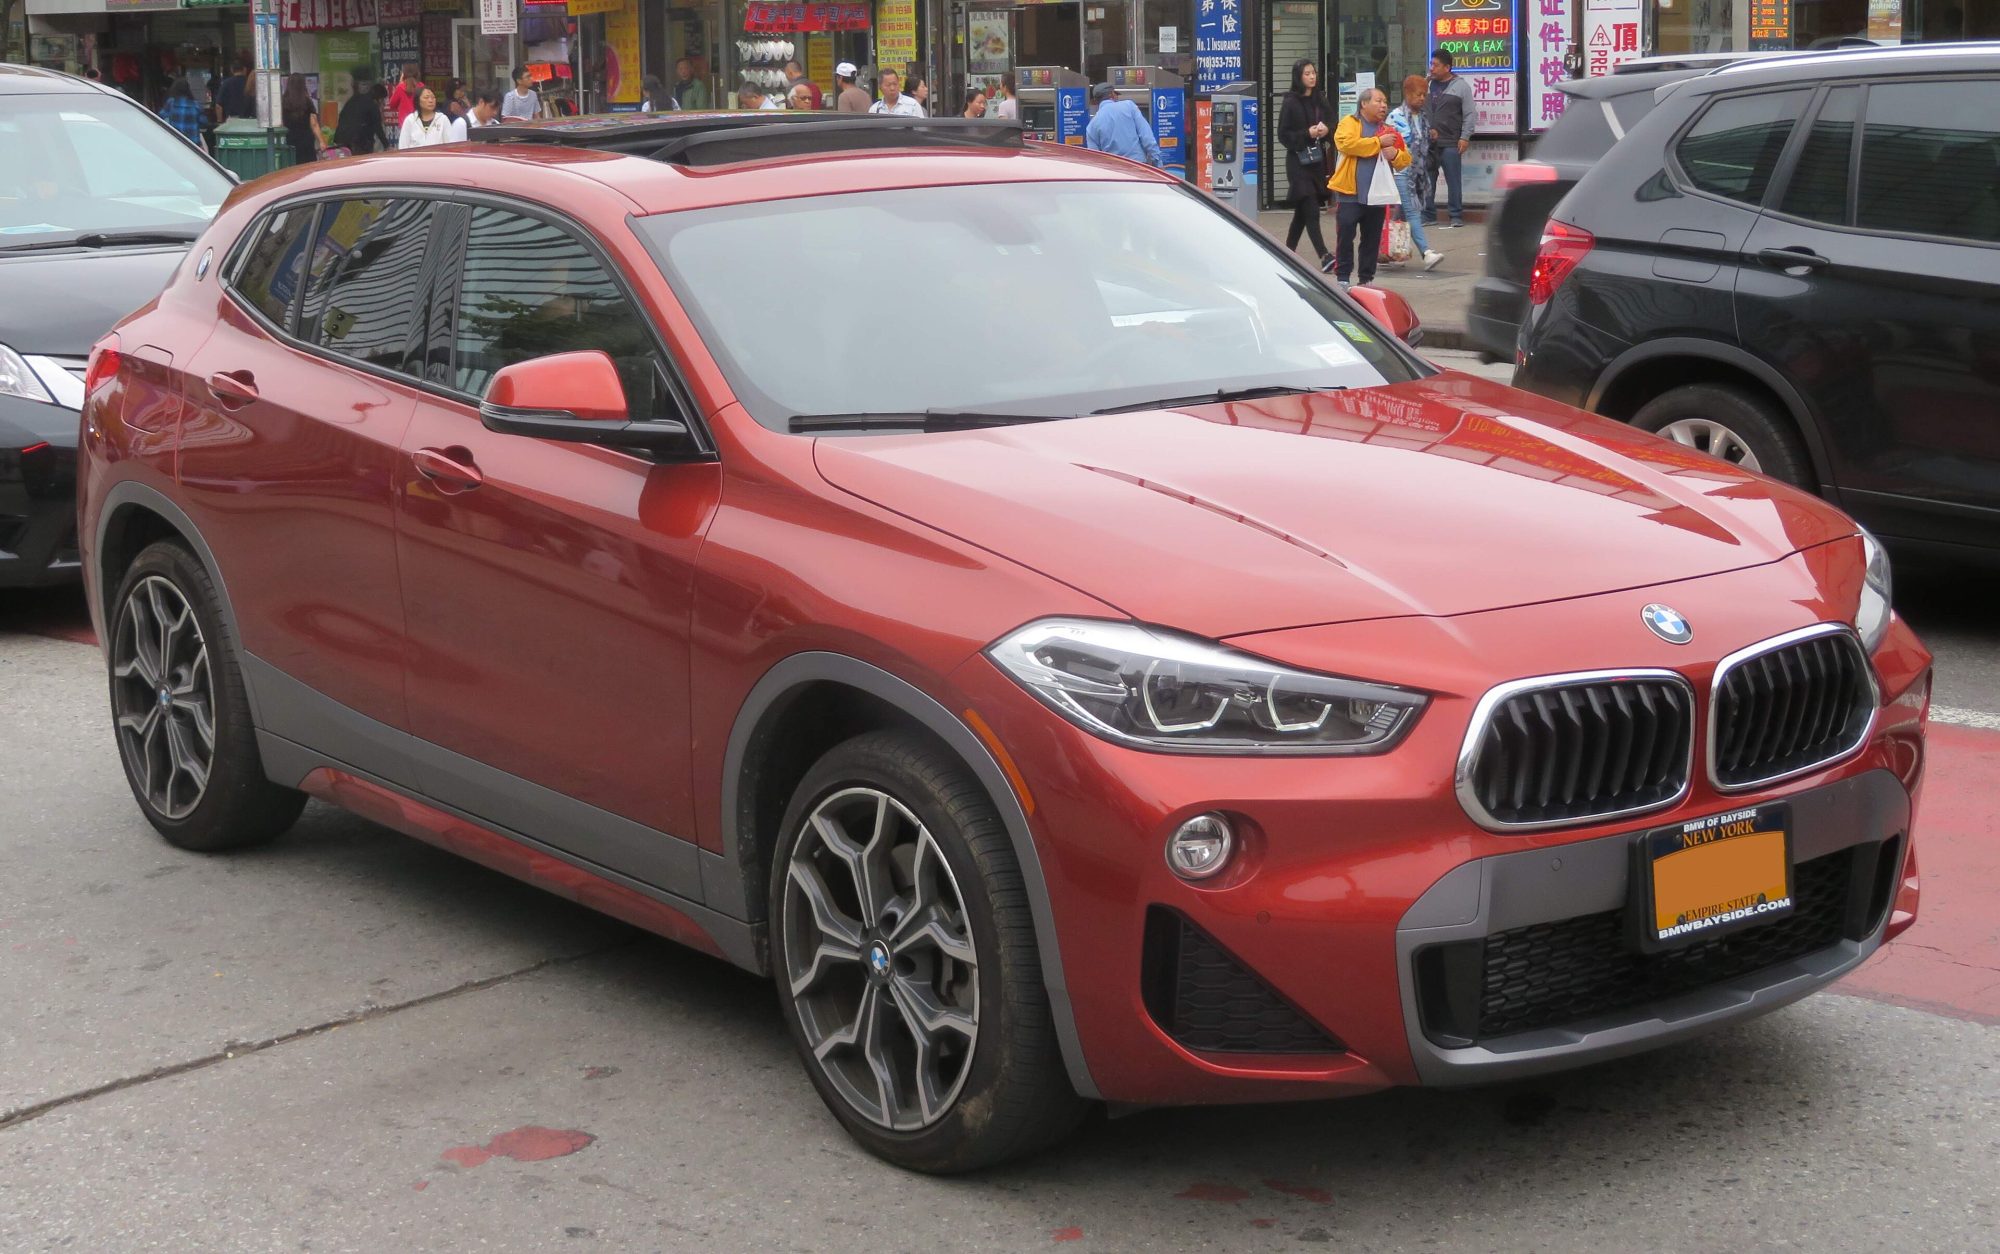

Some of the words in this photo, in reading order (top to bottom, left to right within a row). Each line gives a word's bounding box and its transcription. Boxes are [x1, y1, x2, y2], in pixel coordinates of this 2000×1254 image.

[1440, 40, 1470, 53] COPY
[1472, 40, 1481, 53] &
[1483, 39, 1504, 52] FAX
[1475, 56, 1511, 68] PHOTO
[1683, 821, 1705, 833] BMW
[1707, 817, 1719, 827] OF
[1720, 809, 1757, 824] BAYSIDE
[1683, 829, 1716, 848] NEW
[1719, 819, 1756, 839] YORK
[1658, 897, 1791, 940] BMWBAYSIDE.COM
[1685, 903, 1724, 921] EMPIRE
[1727, 893, 1758, 911] STATE
